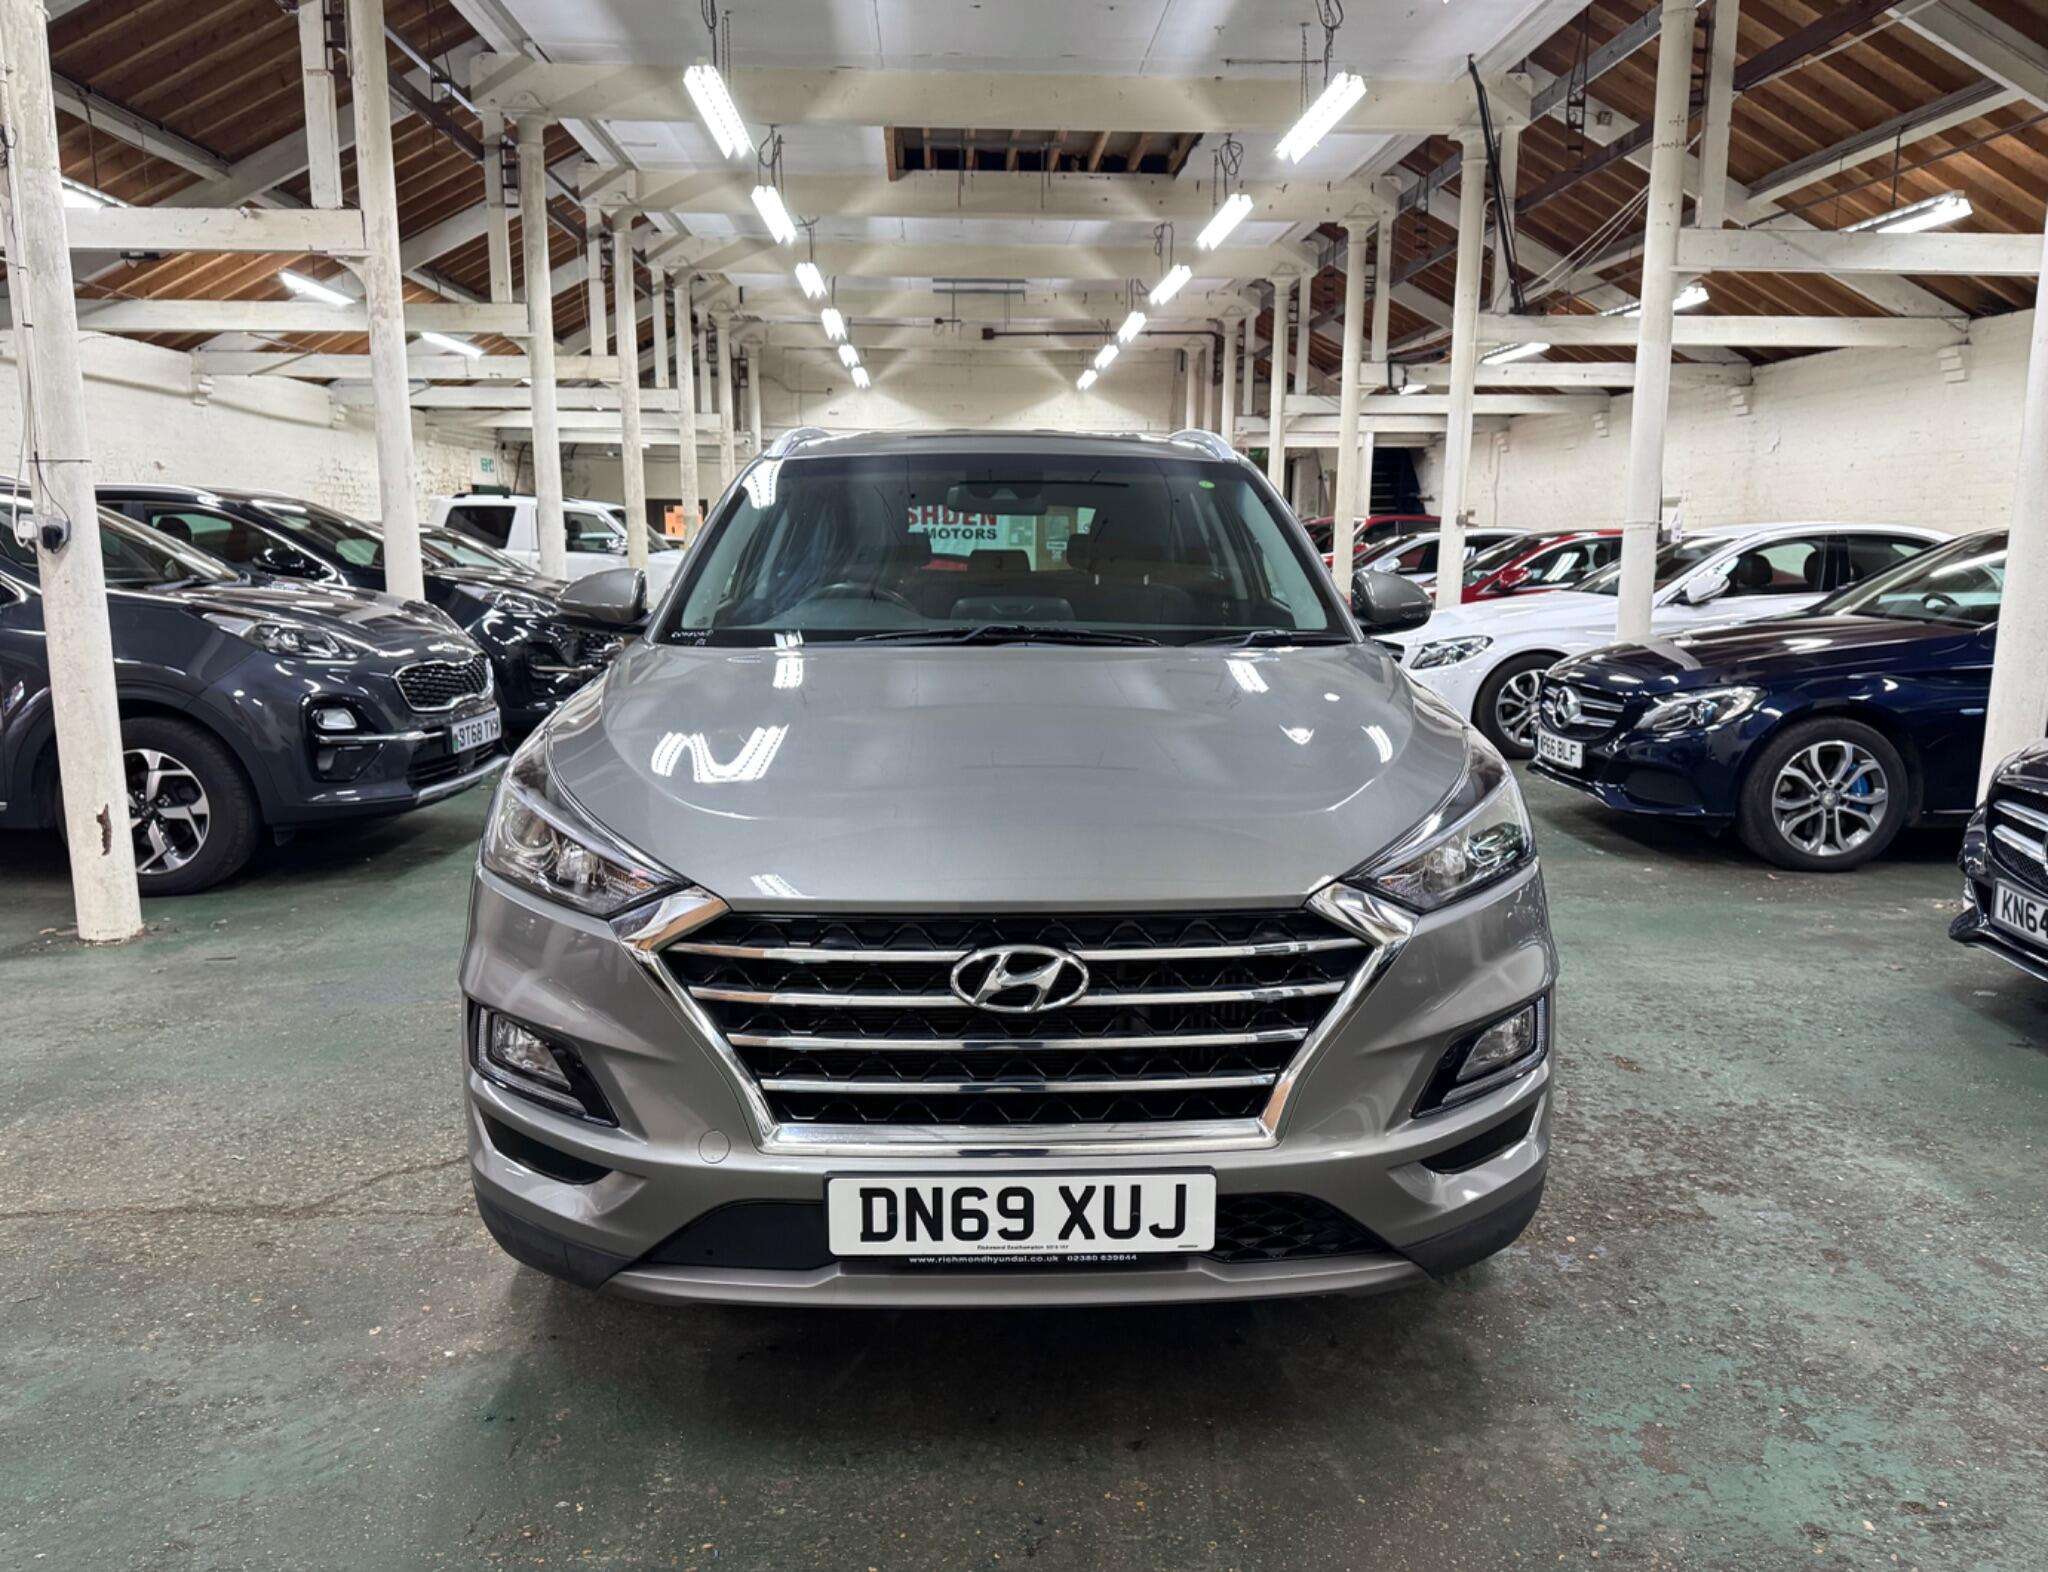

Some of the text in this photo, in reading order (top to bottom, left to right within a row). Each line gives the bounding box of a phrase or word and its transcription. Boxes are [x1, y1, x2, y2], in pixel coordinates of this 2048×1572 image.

[924, 528, 997, 540] MOTORS
[2002, 889, 2048, 939] KN64
[860, 1184, 1187, 1242] DN69 XUJ
